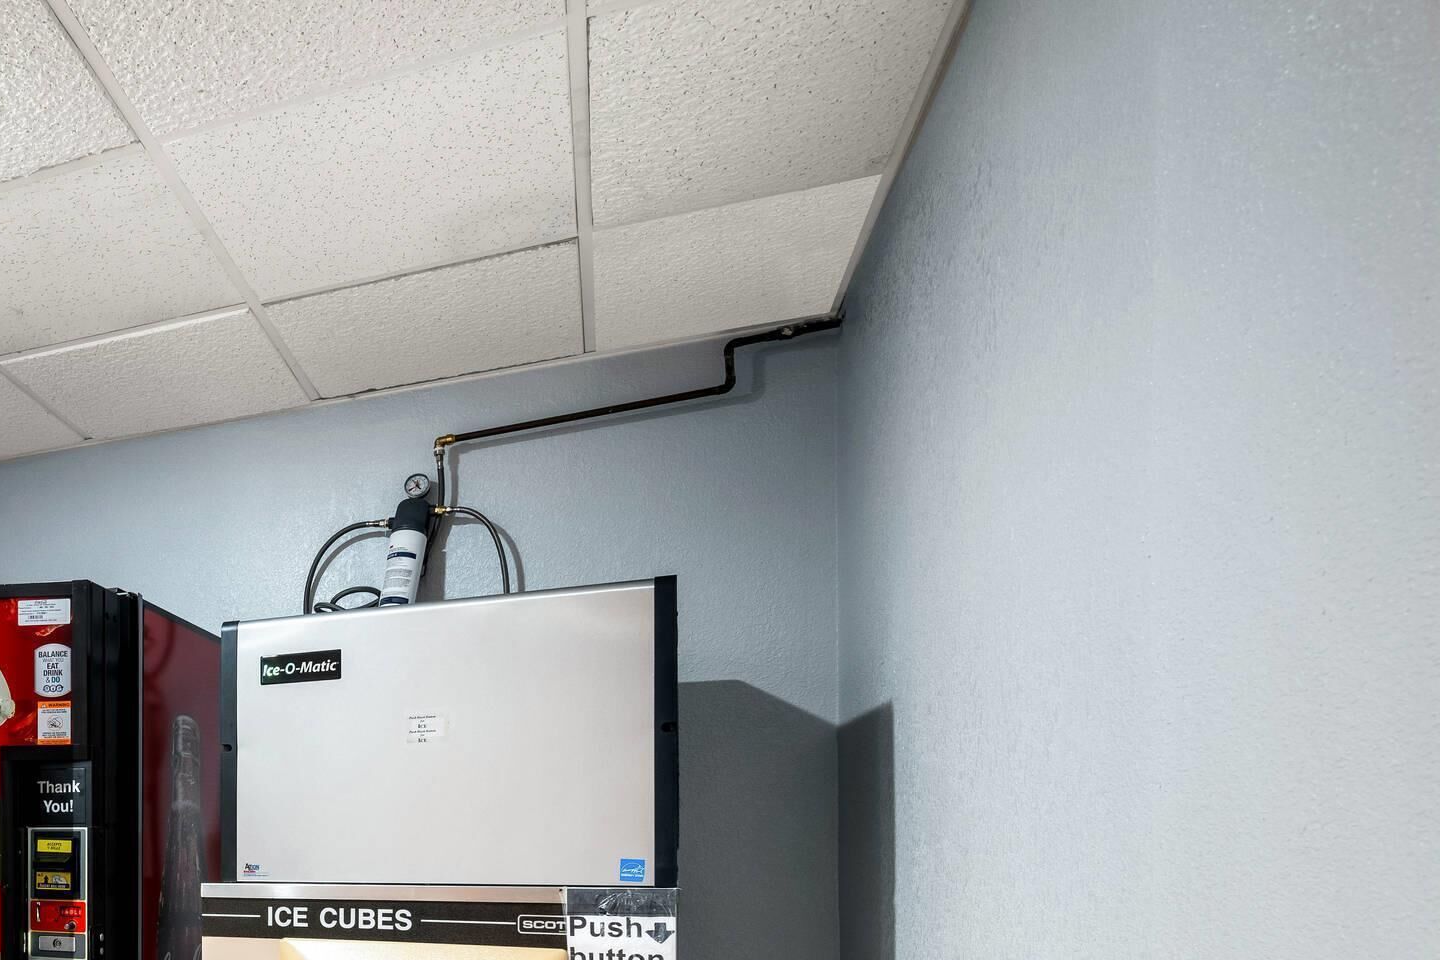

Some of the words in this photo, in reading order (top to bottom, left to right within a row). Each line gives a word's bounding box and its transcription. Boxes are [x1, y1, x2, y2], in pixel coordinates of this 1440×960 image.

[38, 650, 68, 658] BALANCE
[43, 669, 63, 677] DRINK
[262, 659, 337, 677] Ice-O-Matic
[37, 780, 80, 793] Thank
[43, 800, 73, 813] You!
[267, 906, 308, 927] ICE
[319, 907, 413, 931] CUBES
[570, 916, 642, 937] Push
